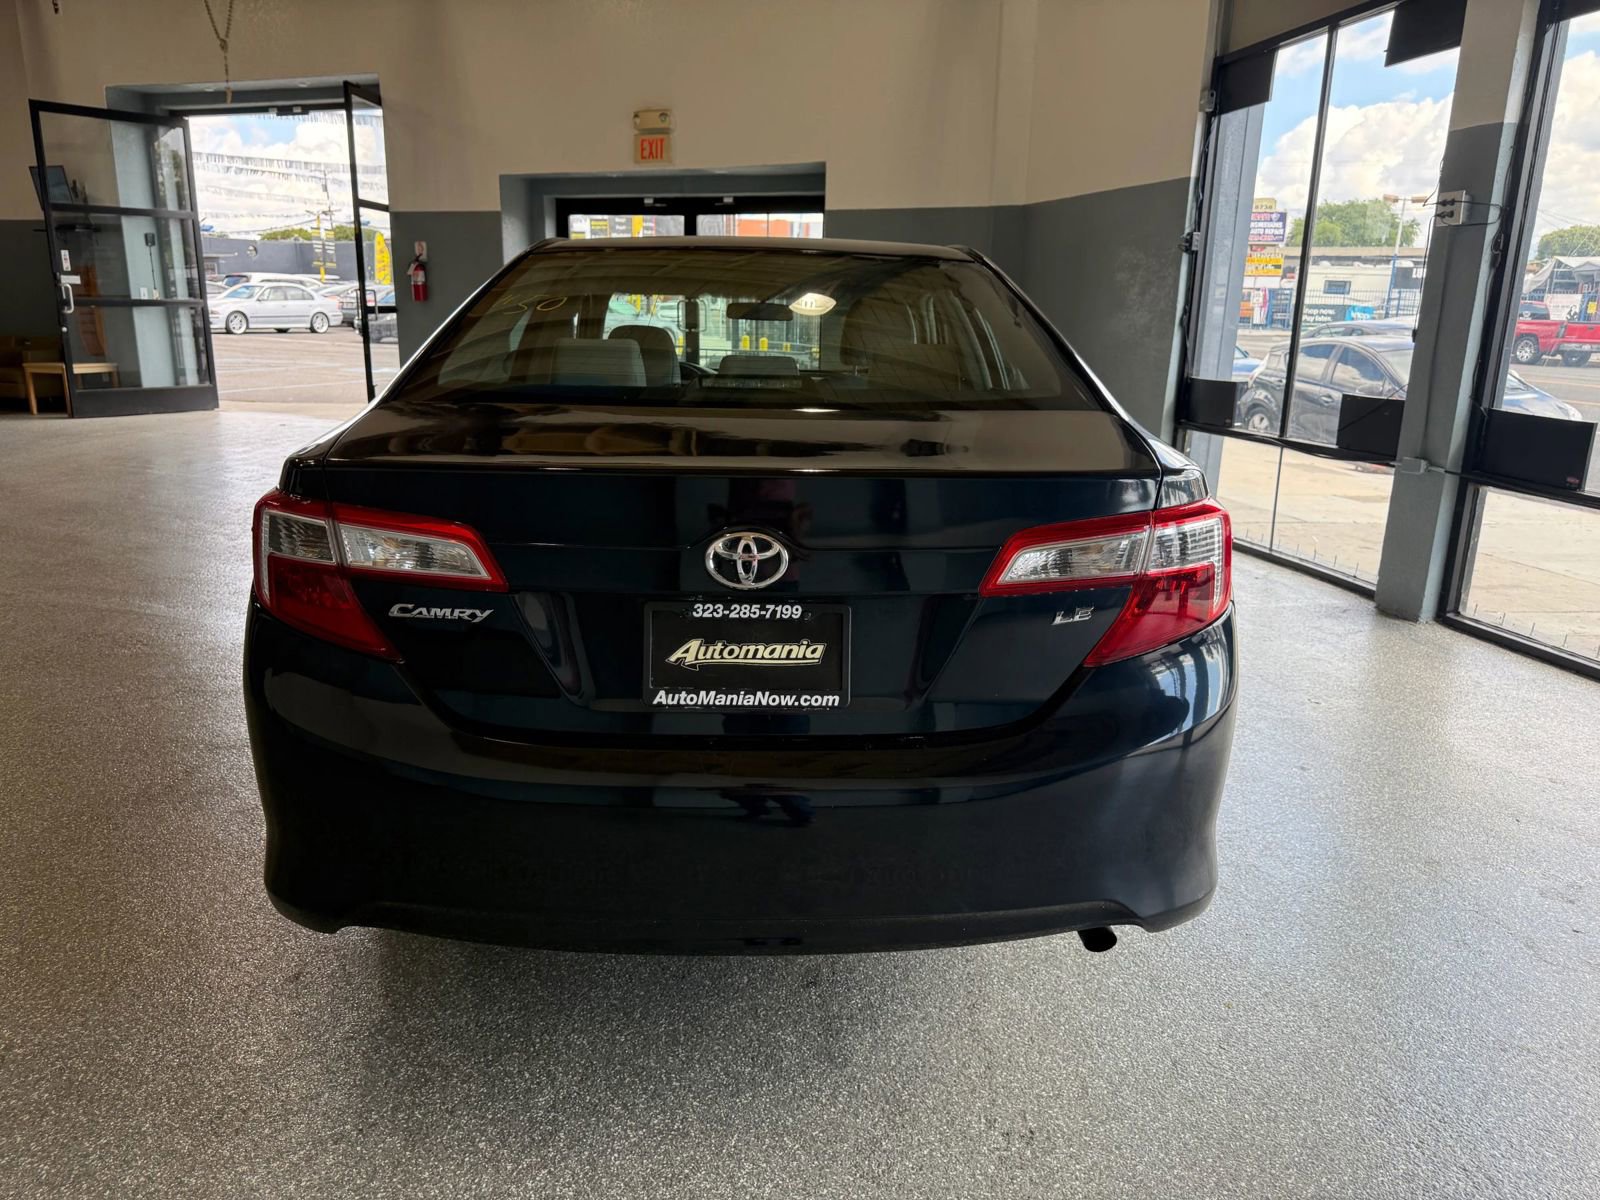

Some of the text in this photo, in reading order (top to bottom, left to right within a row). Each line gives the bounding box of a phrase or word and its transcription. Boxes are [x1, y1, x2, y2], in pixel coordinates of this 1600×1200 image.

[640, 137, 665, 160] EXIT
[388, 602, 494, 623] CAMRY
[692, 603, 803, 620] 323-285-7199
[1051, 606, 1095, 626] LE
[665, 638, 827, 666] Automania
[652, 690, 840, 707] AutoManiaNow.com
